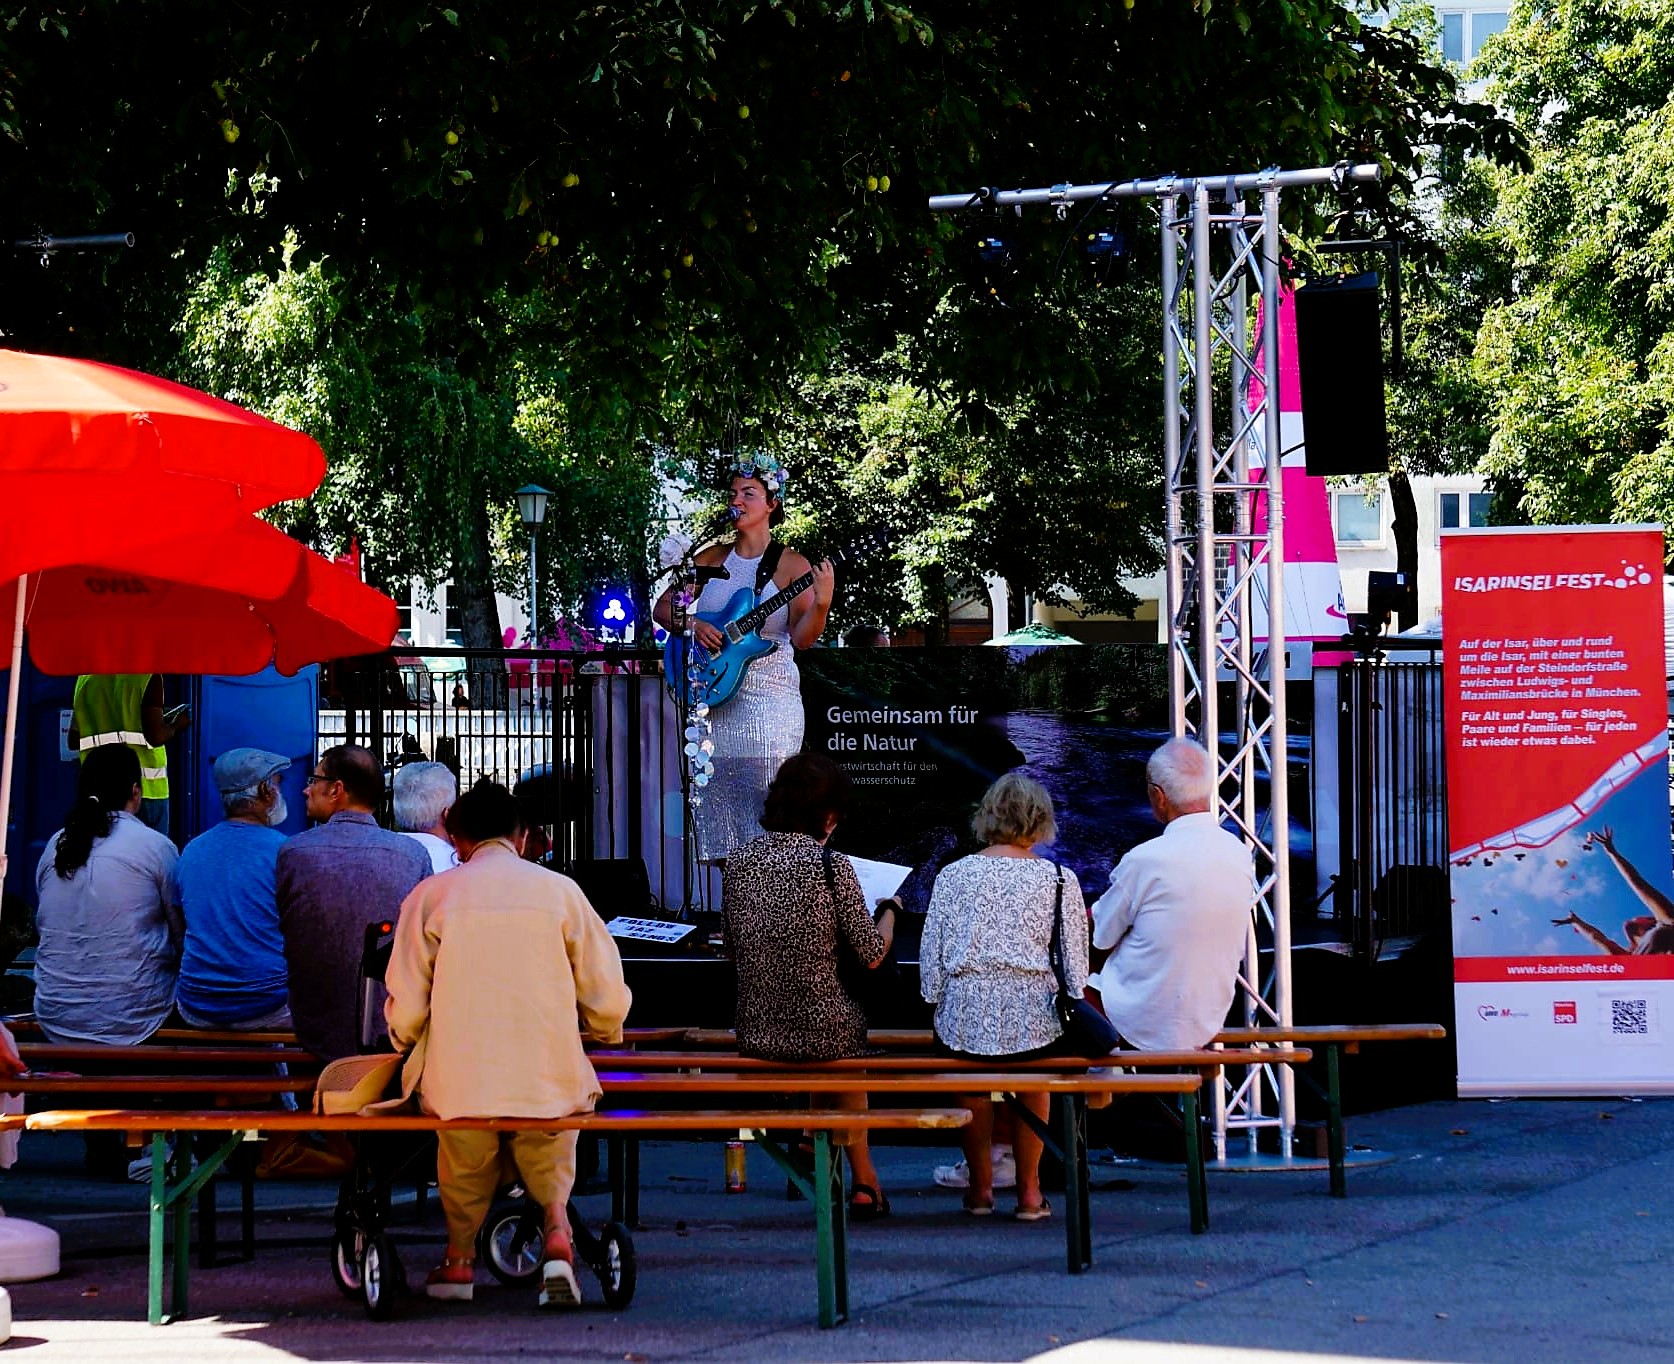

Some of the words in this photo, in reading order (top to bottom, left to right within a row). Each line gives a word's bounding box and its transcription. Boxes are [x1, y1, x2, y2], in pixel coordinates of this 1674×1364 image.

[1459, 639, 1479, 649] Auf
[1482, 638, 1501, 648] der
[1504, 638, 1529, 649] Isar,
[1532, 636, 1558, 647] über
[1561, 636, 1583, 646] und
[1586, 636, 1613, 646] rund
[1459, 653, 1478, 662] um
[1480, 651, 1499, 661] die
[1501, 650, 1526, 662] Isar,
[1529, 650, 1549, 661] mit
[1551, 649, 1581, 660] einer
[1583, 649, 1624, 659] bunten
[1460, 664, 1491, 674] Meile
[1494, 663, 1513, 674] auf
[1516, 663, 1535, 673] der
[1538, 661, 1628, 673] Steindorfstraße
[1460, 677, 1514, 688] zwischen
[1517, 675, 1568, 688] Ludwigs-
[1571, 675, 1594, 685] und
[1461, 688, 1568, 700] Maximiliansbrücke
[1571, 688, 1583, 698] in
[1586, 687, 1641, 697] München.
[827, 706, 943, 724] Gemeinsam
[948, 705, 978, 724] für
[1461, 710, 1481, 721] Für
[1483, 710, 1500, 720] Alt
[1503, 709, 1525, 720] und
[1527, 709, 1559, 721] Jung,
[1562, 708, 1579, 719] für
[1581, 708, 1627, 719] Singles,
[1462, 725, 1496, 734] Paare
[1498, 723, 1520, 733] und
[1523, 722, 1572, 733] Familien
[1586, 722, 1602, 732] für
[1604, 722, 1637, 734] jeden
[827, 733, 858, 750] die
[863, 734, 917, 751] Natur
[1462, 736, 1478, 747] ist
[1481, 735, 1520, 746] wieder
[1522, 735, 1557, 745] etwas
[1560, 734, 1596, 745] dabei.
[839, 761, 900, 771] stwirtschaft
[903, 761, 918, 771] für
[920, 761, 938, 771] den
[1506, 963, 1625, 975] www.isarinselfest.de
[1555, 1014, 1574, 1023] SPD
